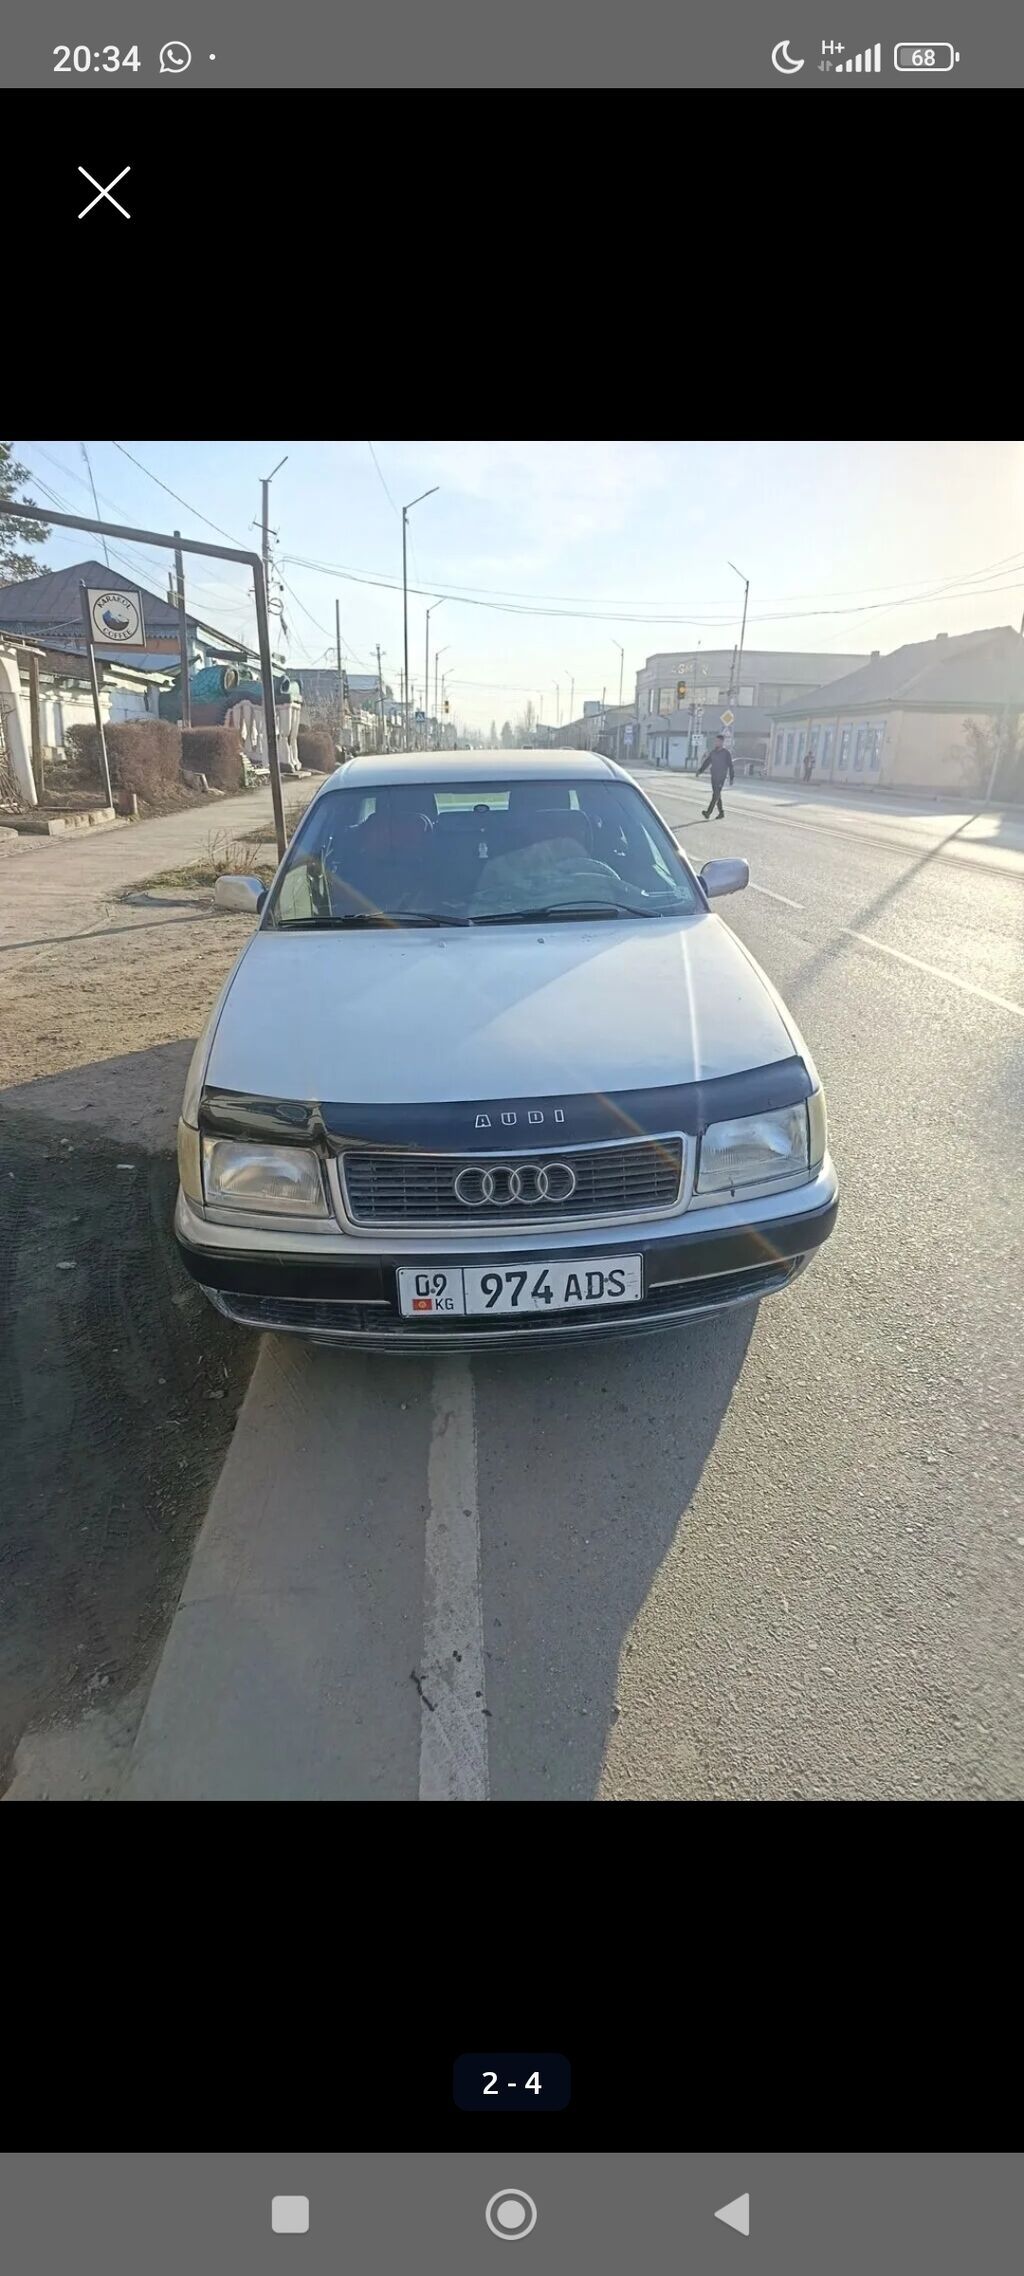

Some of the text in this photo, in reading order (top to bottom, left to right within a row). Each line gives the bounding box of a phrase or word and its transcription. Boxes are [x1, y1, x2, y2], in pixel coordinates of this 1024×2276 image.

[103, 627, 132, 639] COFFEE
[475, 1109, 565, 1128] AUDI
[415, 1269, 627, 1308] 09 974 ADS
[435, 1298, 454, 1311] KG
